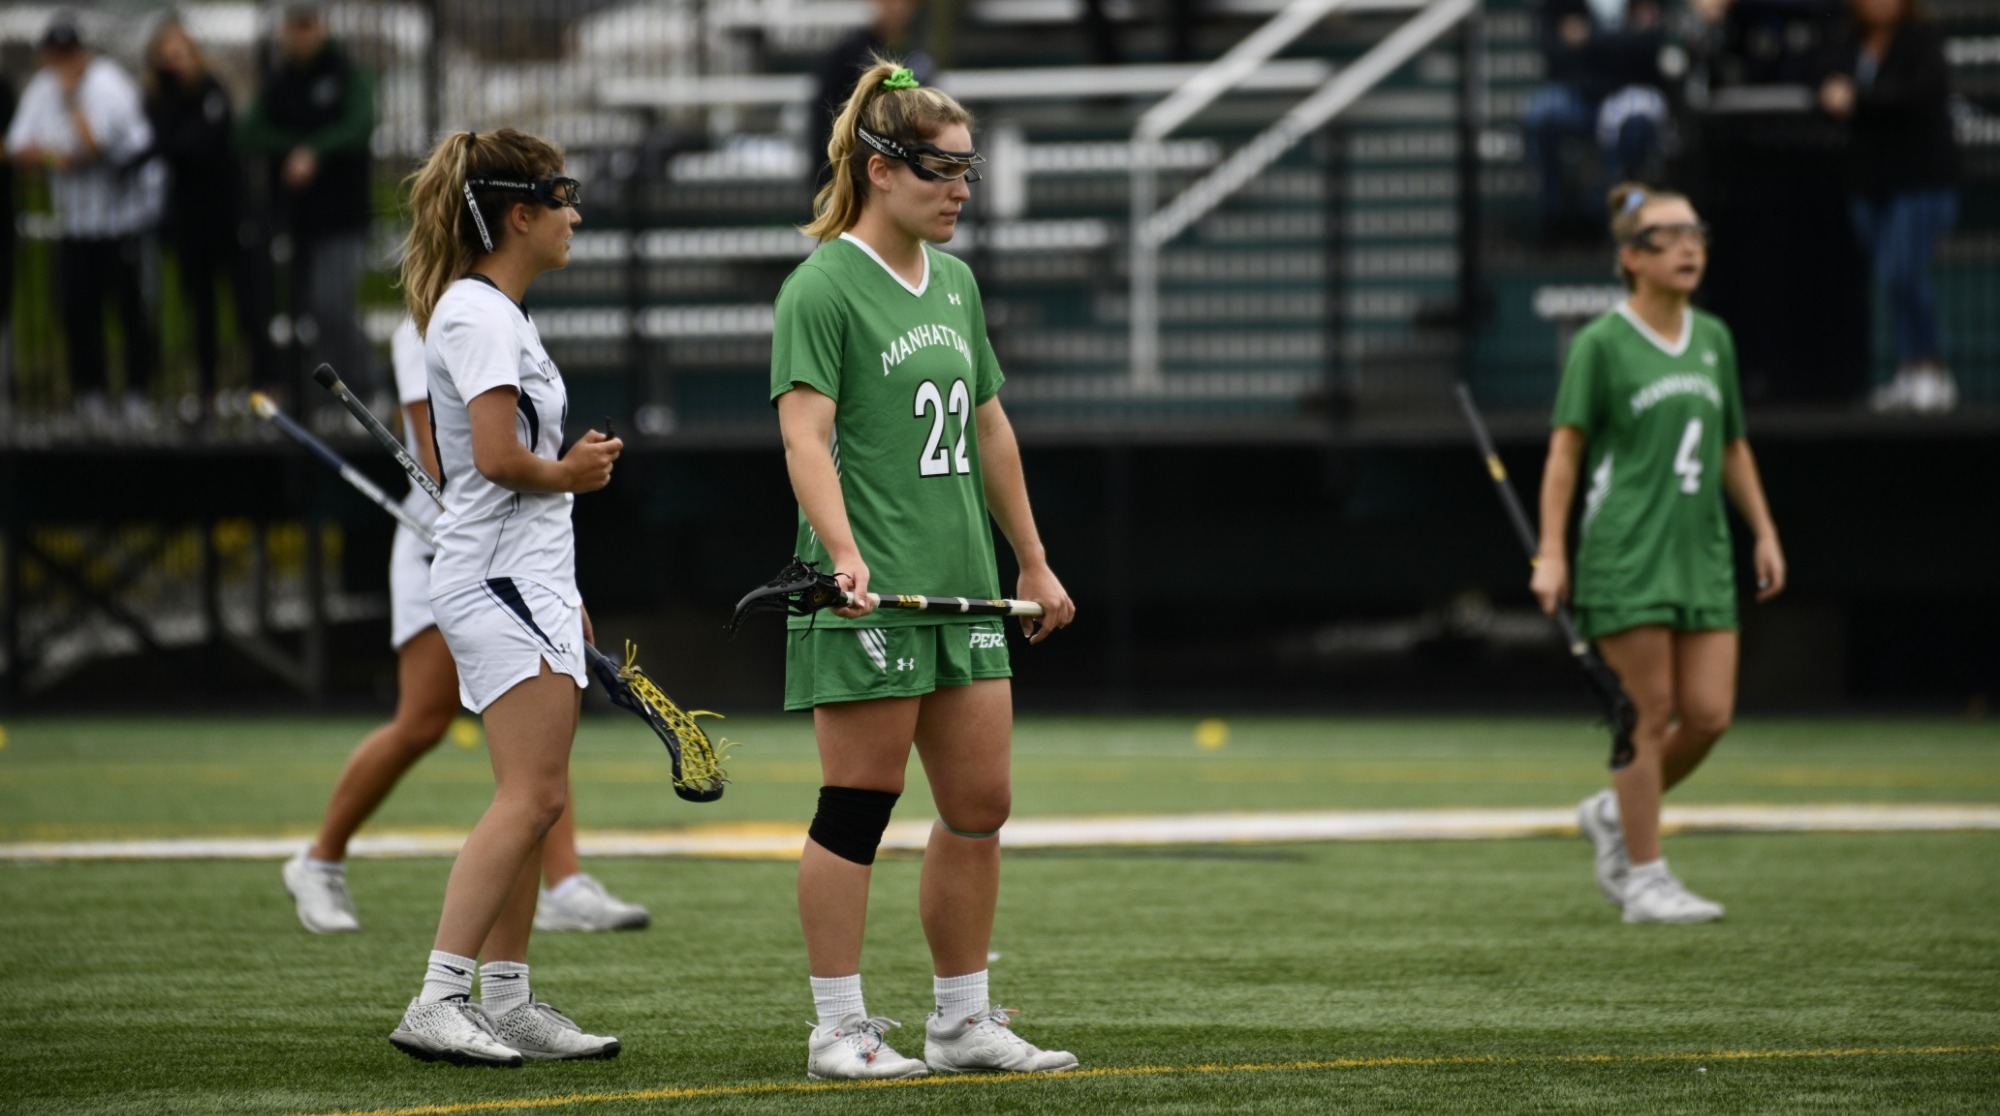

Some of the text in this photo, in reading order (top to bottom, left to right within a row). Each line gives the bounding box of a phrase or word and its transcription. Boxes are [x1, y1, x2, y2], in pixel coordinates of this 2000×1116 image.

[913, 378, 971, 478] 22
[1673, 418, 1703, 494] 4
[968, 632, 1004, 649] PER
